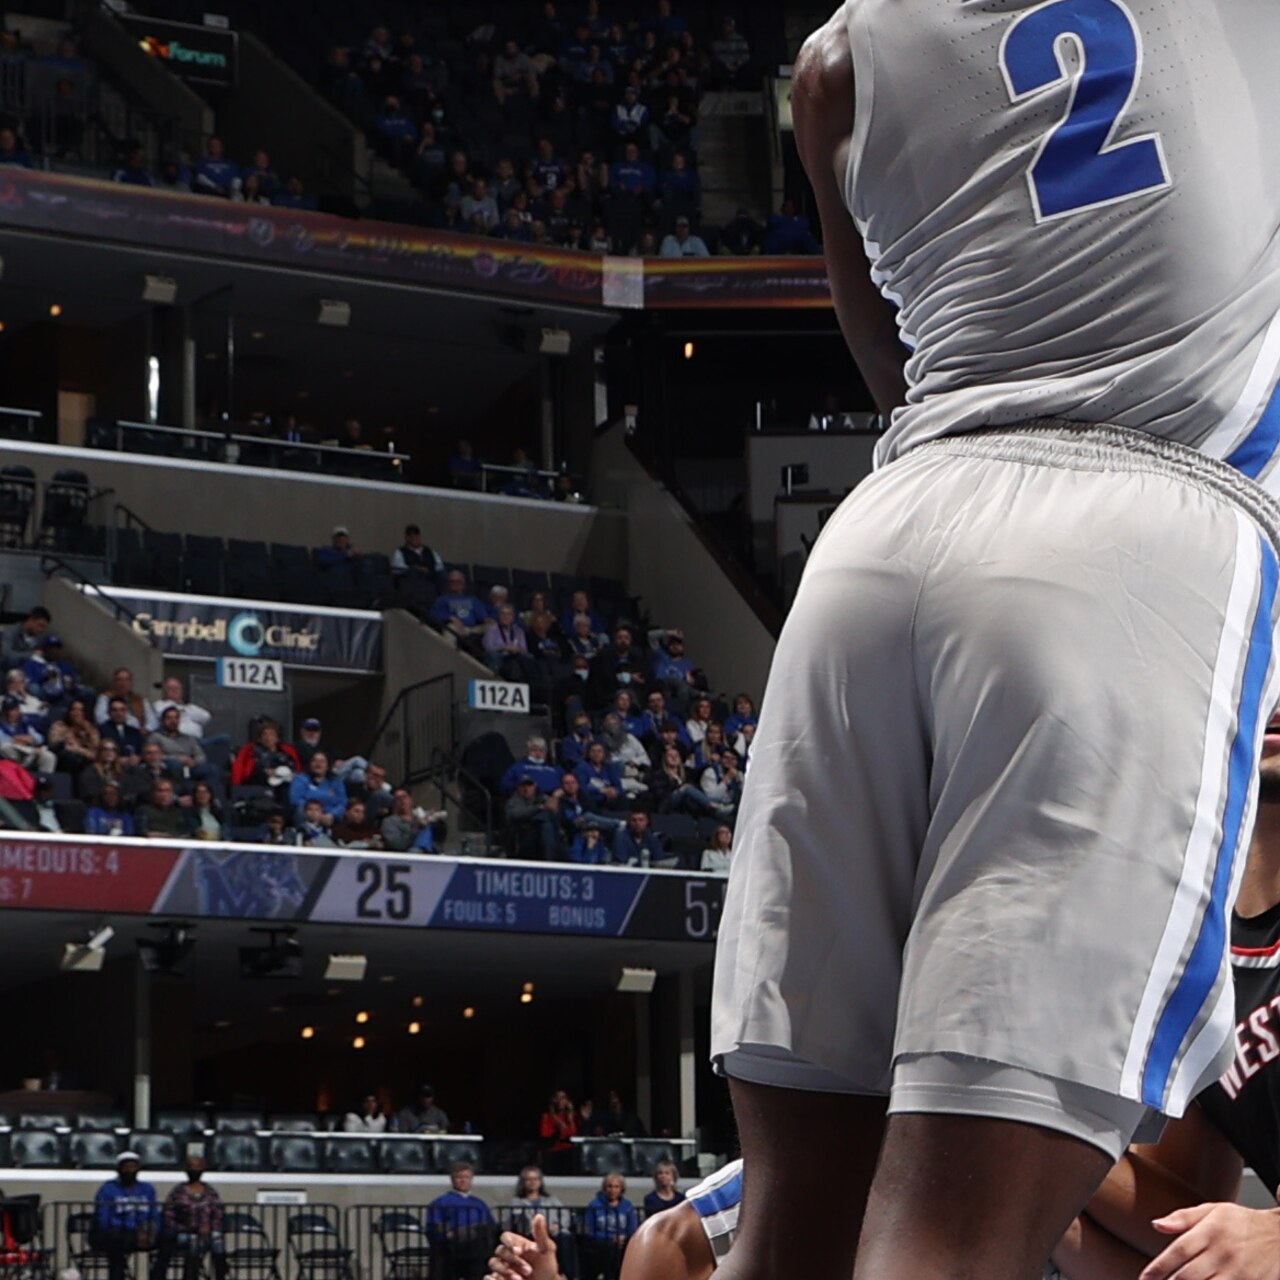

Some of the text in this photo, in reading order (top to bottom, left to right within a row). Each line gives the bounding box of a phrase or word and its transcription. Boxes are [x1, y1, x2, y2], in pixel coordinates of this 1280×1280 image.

[131, 612, 320, 651] Campbell Clinic
[227, 663, 279, 686] 112A
[478, 684, 526, 708] 112A
[104, 849, 119, 874] 4
[355, 862, 412, 920] 25
[473, 869, 594, 901] TIMEOUTS: 3
[443, 900, 606, 929] FOULS: 5 BONUS
